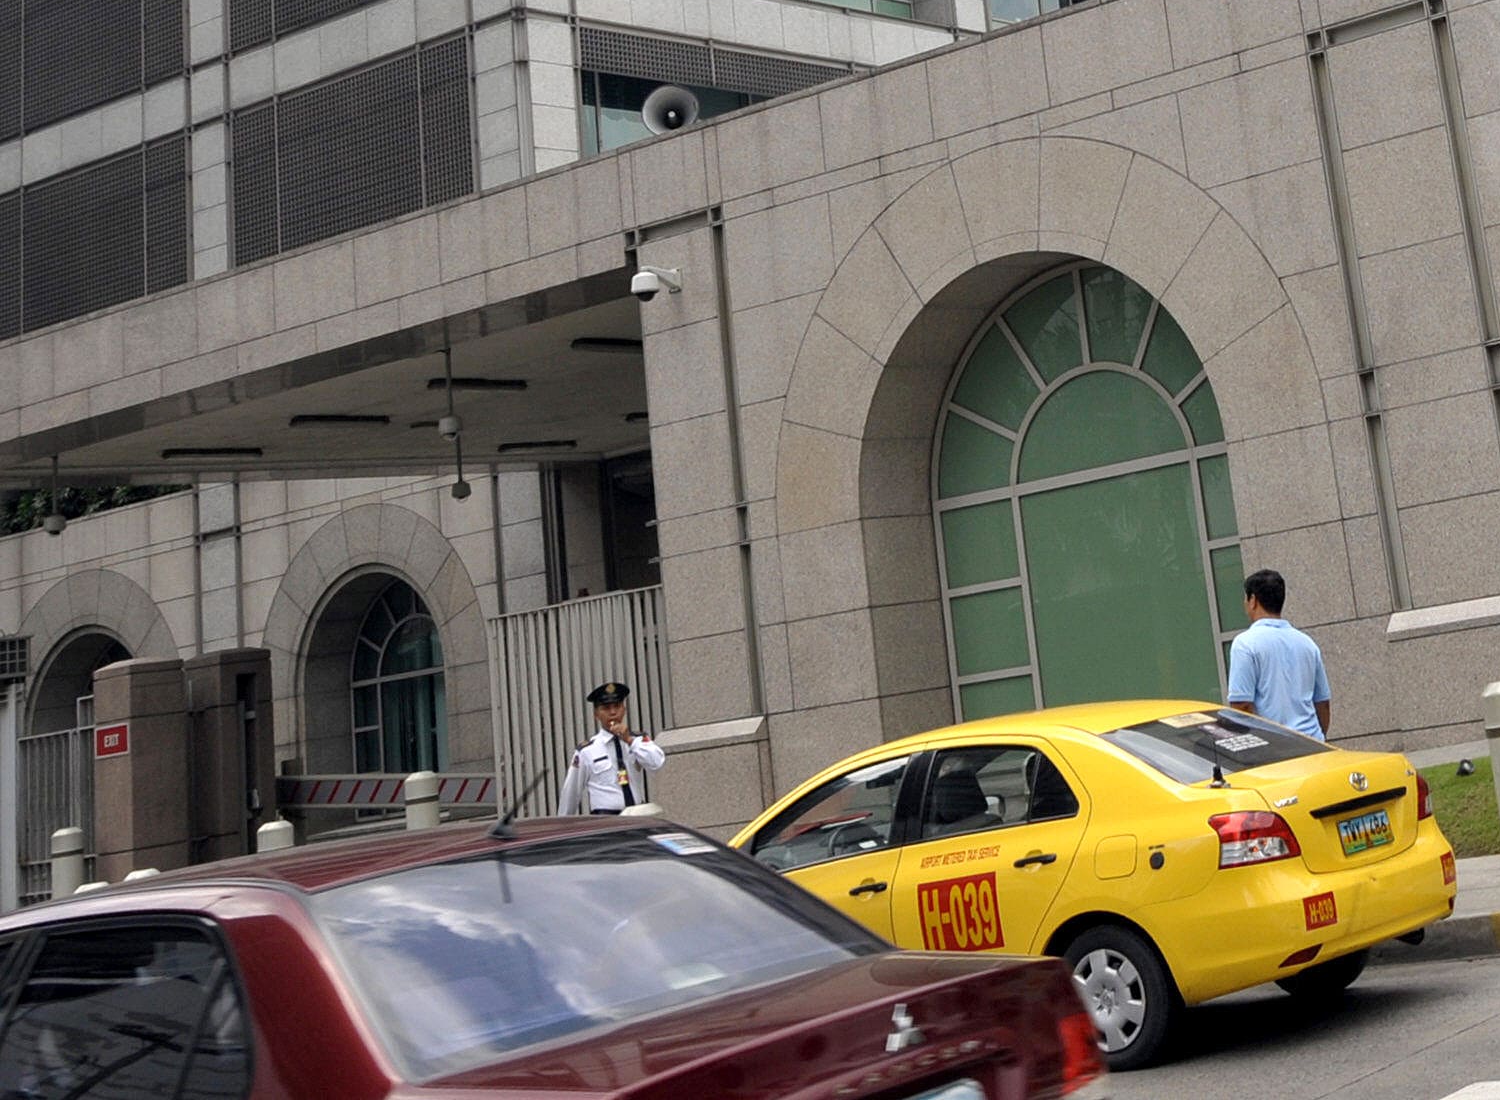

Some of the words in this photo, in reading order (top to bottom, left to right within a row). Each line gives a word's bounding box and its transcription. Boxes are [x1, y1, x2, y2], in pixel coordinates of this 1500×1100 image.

[104, 734, 119, 748] EXIT
[921, 879, 998, 950] H-039
[1309, 898, 1334, 924] H-039
